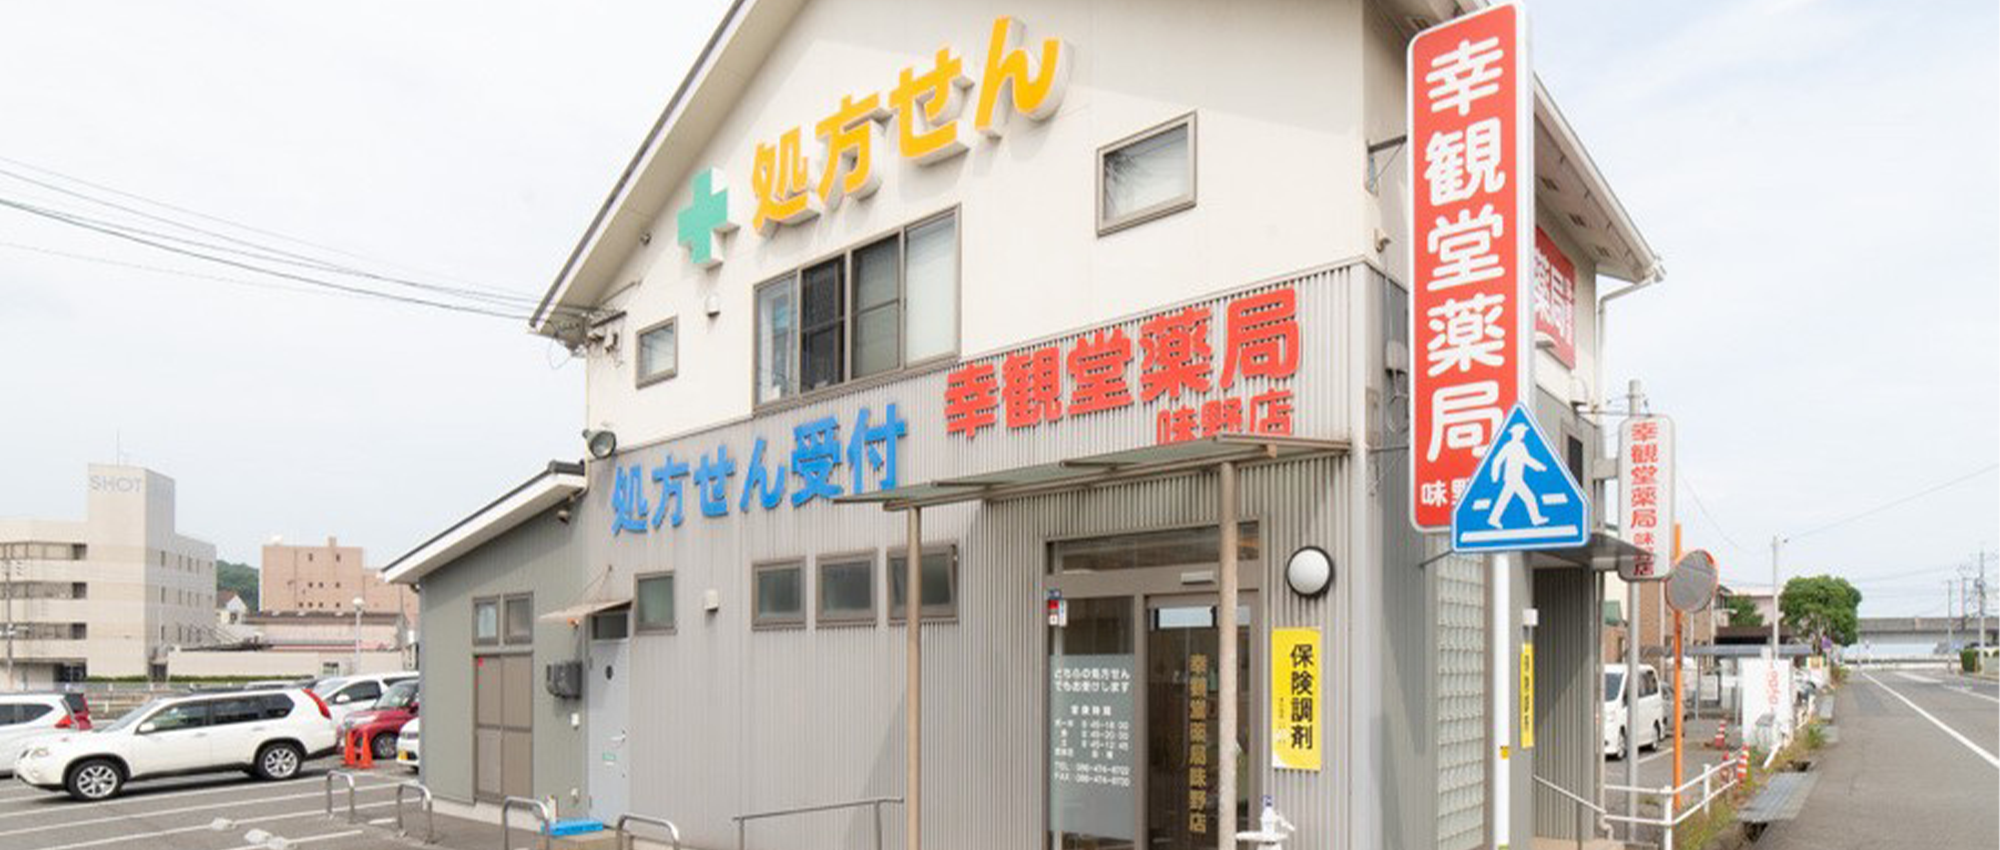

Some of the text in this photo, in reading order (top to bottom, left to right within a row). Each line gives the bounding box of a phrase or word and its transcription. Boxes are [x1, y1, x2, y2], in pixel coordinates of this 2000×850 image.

[752, 16, 1060, 231] 処方せん
[1424, 36, 1506, 463] 幸観堂薬局
[944, 287, 1301, 439] 幸観堂薬局
[1156, 387, 1292, 446] 味野店
[88, 475, 142, 493] SHOT
[611, 402, 907, 535] 処方せん受付
[1290, 643, 1314, 750] 保険調剤
